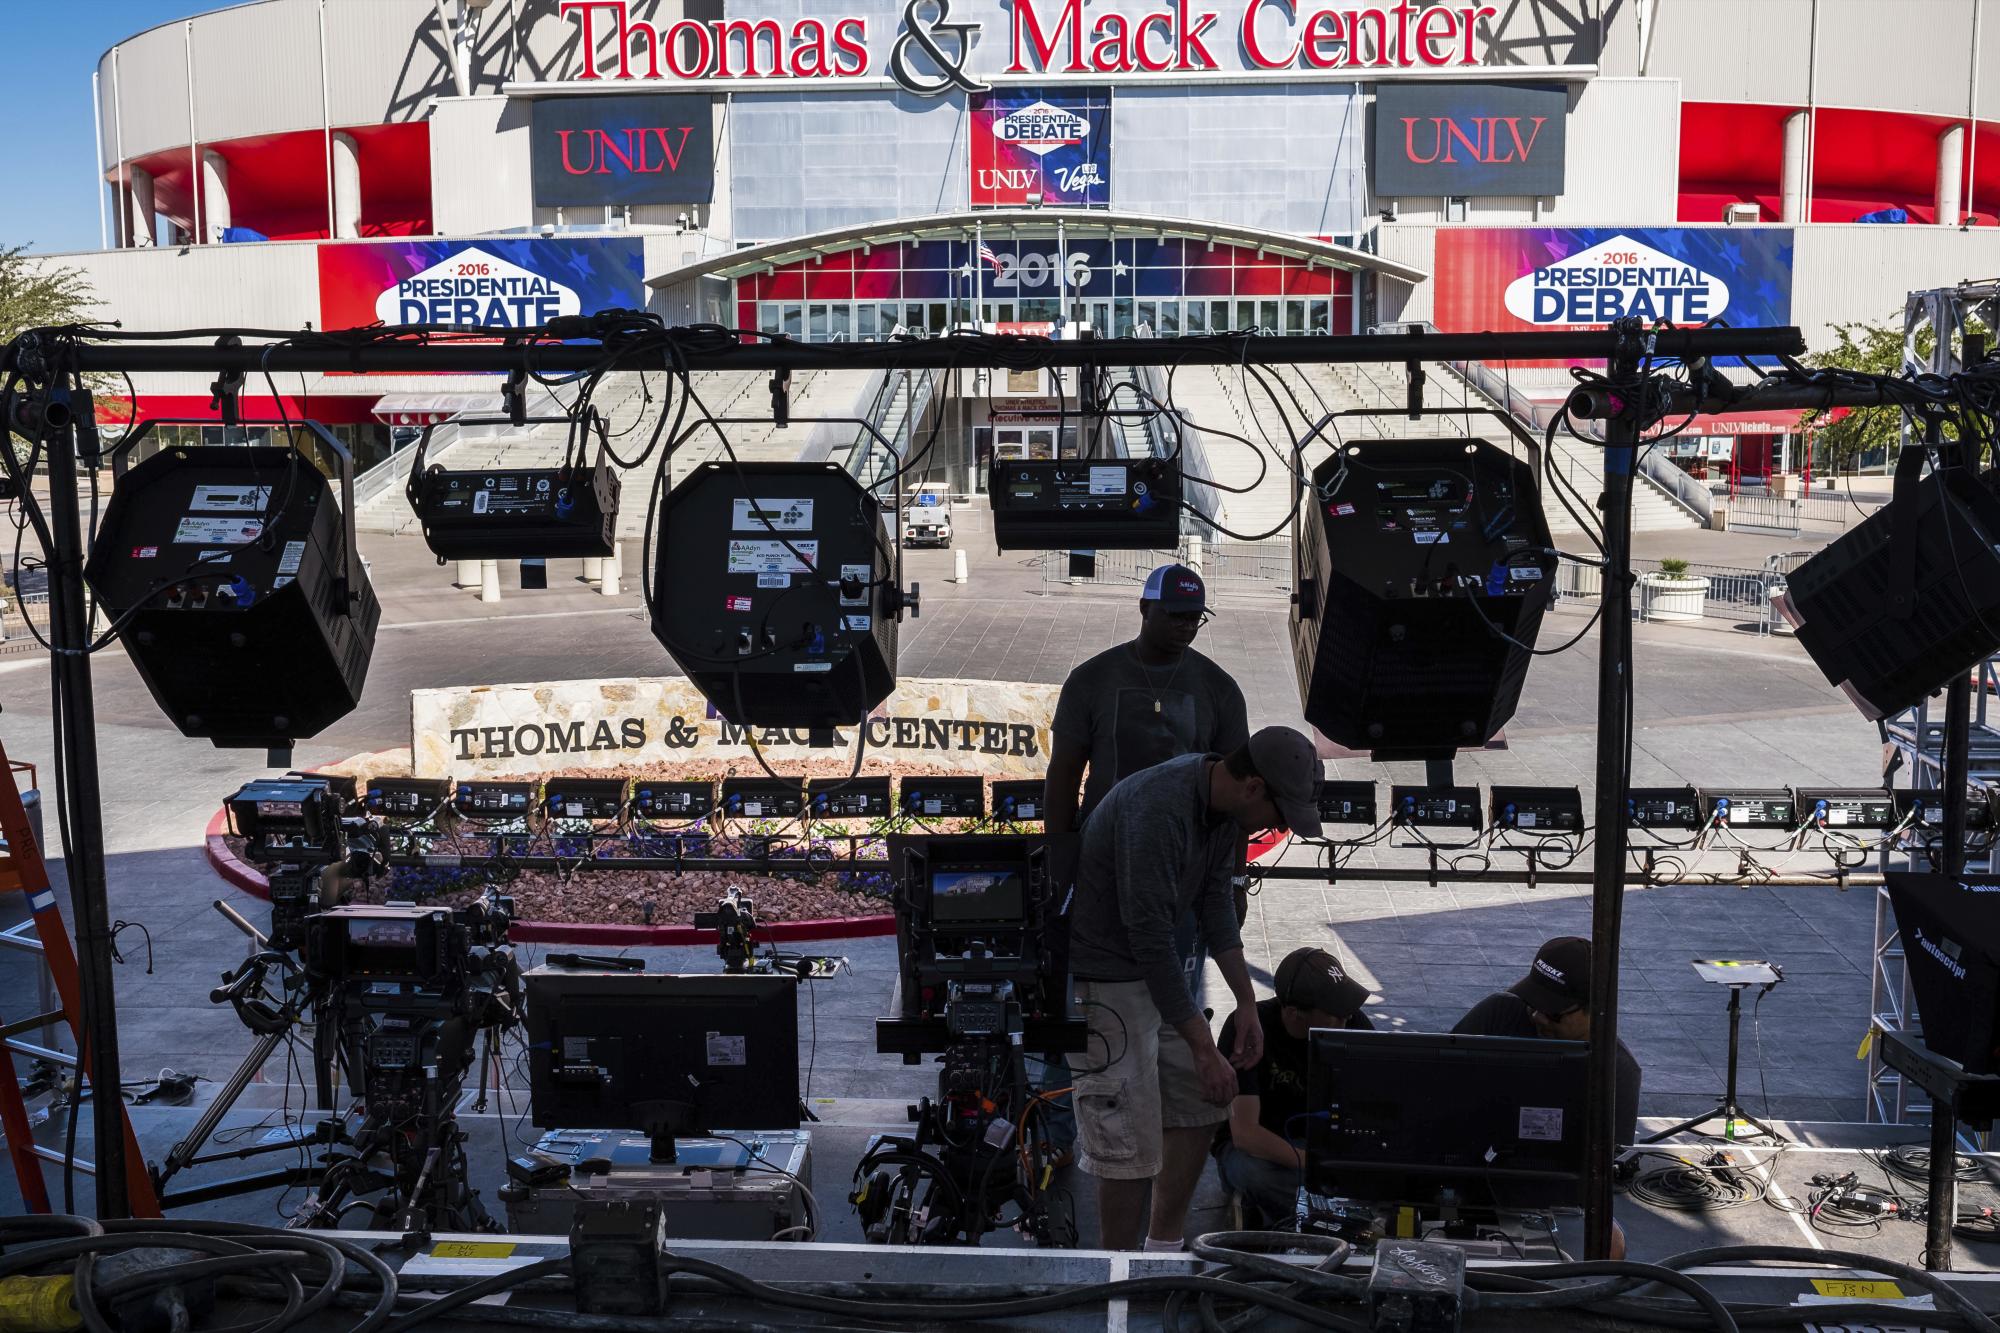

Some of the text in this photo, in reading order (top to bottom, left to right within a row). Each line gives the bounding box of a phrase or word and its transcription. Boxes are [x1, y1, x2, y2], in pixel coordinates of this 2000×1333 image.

[560, 0, 1499, 96] Thomas & Mack Center
[1004, 115, 1081, 123] PRESIDENTIAL
[1004, 123, 1081, 139] DEBATE
[555, 128, 694, 175] UNLV
[1400, 117, 1547, 164] UNLV
[978, 169, 1037, 190] UNLV
[1054, 166, 1105, 193] Vegas
[457, 263, 490, 276] 2016
[993, 252, 1092, 287] 2016
[1602, 252, 1638, 265] 2016
[399, 277, 560, 298] PRESIDENTIAL
[1534, 267, 1709, 287] PRESIDENTIAL
[399, 297, 561, 328] DEBATE
[1533, 287, 1710, 323] DEBATE
[1711, 421, 1786, 434] UNLVtickets.com
[450, 717, 647, 760] THOMAS
[664, 716, 700, 750] &
[866, 716, 1038, 757] CENTER
[1920, 937, 1967, 980] autoscript
